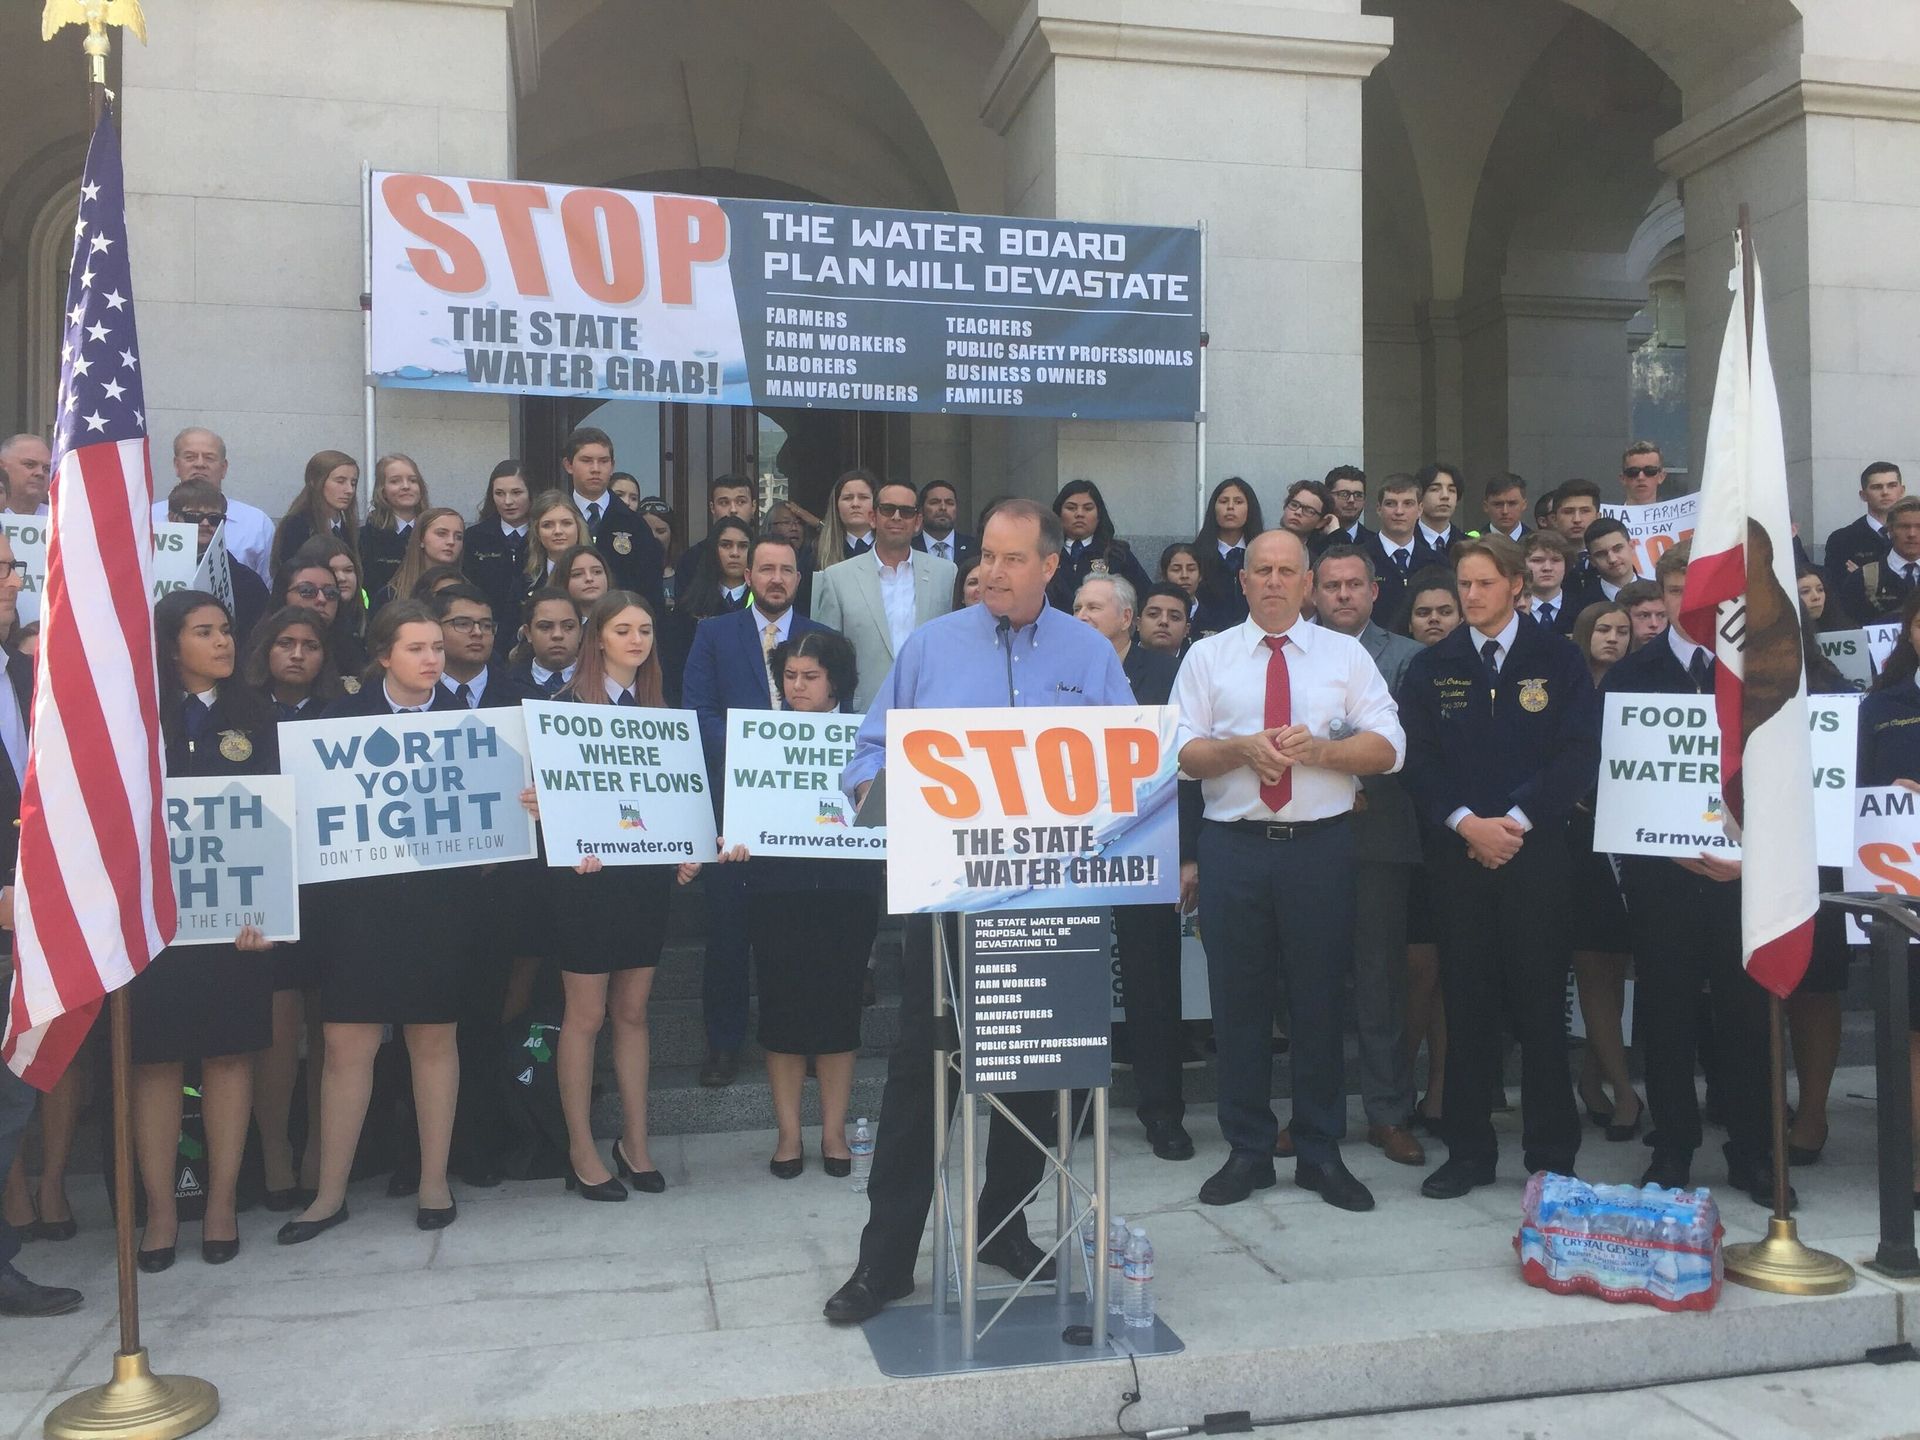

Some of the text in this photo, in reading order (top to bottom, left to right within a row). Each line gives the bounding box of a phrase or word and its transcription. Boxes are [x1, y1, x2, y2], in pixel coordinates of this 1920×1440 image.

[381, 173, 729, 305] STOP
[763, 211, 1126, 262] THE WATER BOARD
[763, 251, 1189, 303] PLAN WILL DEVASTATE
[447, 306, 639, 351] THE STATE
[766, 306, 848, 329] FARMERS
[946, 316, 1033, 337] TEACHERS
[766, 331, 906, 354] FARM WORKERS
[946, 340, 1194, 367] PUBLIC SAFETY PROFESSIONALS
[464, 348, 719, 396] WATER GRAB!
[766, 355, 857, 375] LABORERS
[946, 363, 1107, 386] BUSINESS OWNERS
[766, 379, 918, 402] MANUFACTURERS
[946, 386, 1023, 405] FAMILIES
[1644, 500, 1697, 521] FARMER
[1652, 522, 1673, 534] SAY
[539, 713, 690, 742] FOOD GROWS
[1621, 706, 1707, 728] FOOD
[742, 720, 815, 741] FOOD
[579, 743, 662, 767] WHERE
[355, 765, 466, 799] YOUR
[541, 769, 704, 793] WATER FLOWS
[734, 768, 829, 791] WATER
[902, 727, 1160, 819] STOP
[1609, 760, 1720, 784] WATER
[1859, 792, 1915, 817] AM
[316, 792, 501, 846] FIGHT
[320, 834, 505, 866] DON'T GO WITH THE FLOW
[576, 838, 693, 856] farmwater.org
[952, 825, 1095, 856] THE STATE
[965, 855, 1155, 888] WATER GRAB!
[191, 913, 218, 929] THE
[226, 911, 265, 928] FLOW
[975, 916, 1100, 927] THE STATE WATER BOARD
[975, 927, 1071, 938] PROPOSAL WILL BE
[975, 938, 1057, 949] DEVASTATING TO
[975, 964, 1017, 974] FARMERS
[975, 978, 1047, 989] FARM WORKERS
[975, 994, 1022, 1005] LABORERS
[975, 1009, 1053, 1021] MANUFACTURERS
[975, 1025, 1022, 1035] TEACHERS
[975, 1037, 1108, 1051] PUBLIC SAFETY PROFESSIONALS
[975, 1054, 1062, 1067] BUSINESS OWNERS
[975, 1071, 1017, 1082] FAMILIES
[1562, 1237, 1649, 1258] CRYSTAL GEYSER
